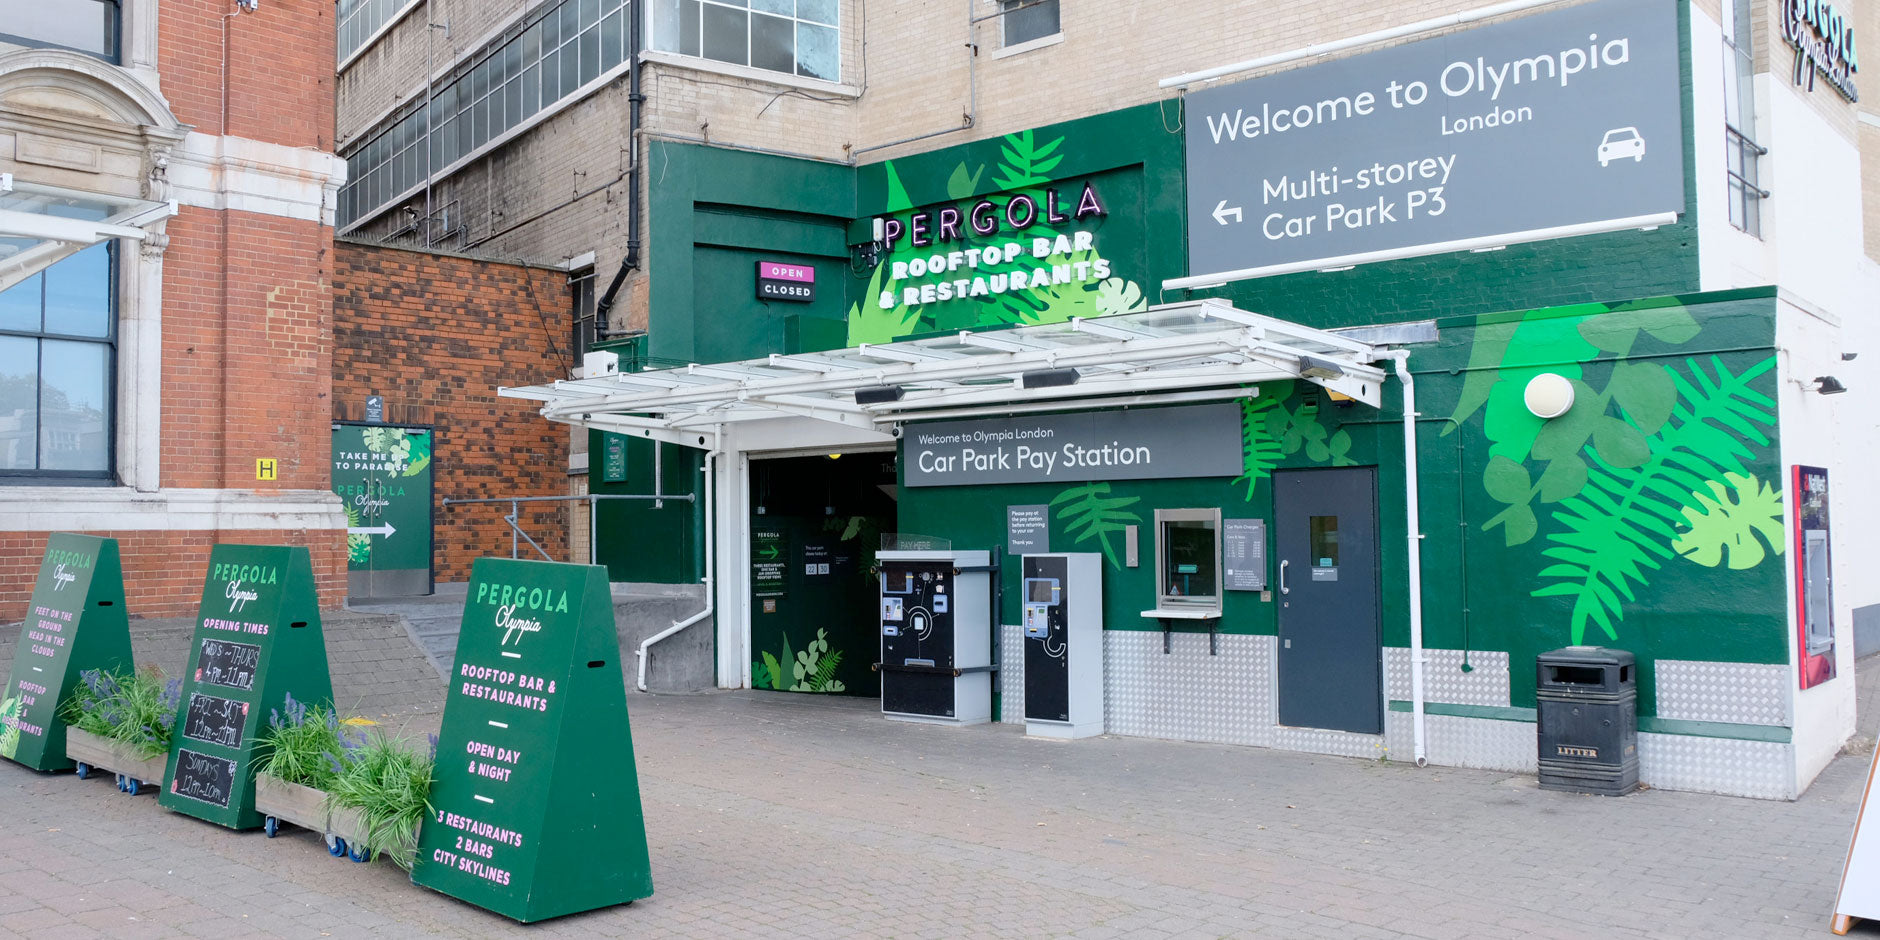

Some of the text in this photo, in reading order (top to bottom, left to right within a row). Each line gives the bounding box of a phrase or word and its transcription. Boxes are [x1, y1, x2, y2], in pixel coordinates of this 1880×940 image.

[1206, 33, 1630, 144] Welcome to Olympia
[1441, 105, 1532, 136] London
[1262, 154, 1456, 204] Multi-storey
[884, 183, 1105, 251] PERGOLA
[1262, 186, 1447, 240] Car Park P3
[892, 230, 1093, 280] ROOFTOP BAR
[772, 267, 803, 278] OPEN
[879, 258, 1111, 309] & RESTAURANTS
[764, 284, 811, 296] CLOSED
[918, 427, 1054, 445] Welcome to Olympia London
[340, 452, 368, 460] TAKE
[354, 462, 408, 471] PARADSE
[918, 441, 1150, 476] Car Park Pay Station
[260, 460, 273, 478] H
[337, 484, 406, 496] PERGOLA
[900, 541, 931, 549] PAY HERE
[46, 549, 91, 569] PERGOLA
[53, 563, 76, 591] Olympia
[213, 563, 277, 585] PERGOLA
[225, 579, 258, 613] Olympia
[476, 582, 568, 613] PERGOLA
[34, 606, 73, 621] FEET ON THE
[495, 603, 541, 646] Olympia
[38, 619, 62, 632] GROUND
[203, 618, 269, 635] OPENING TIMES
[28, 630, 65, 646] HEAD IN THE
[31, 644, 55, 657] CLOUDS
[18, 680, 47, 695] ROOFTOP
[461, 663, 556, 694] ROOFTOP BAR &
[22, 694, 35, 706] BAR
[462, 682, 547, 712] RESTAURANTS
[2, 714, 43, 736] RESAURANTS
[466, 740, 521, 764] OPEN DAY
[1557, 746, 1597, 758] LITTER
[468, 760, 512, 782] & NIGHT
[437, 810, 522, 847] 3 RESTAURANTS
[455, 836, 494, 859] 2 BARS
[433, 848, 511, 886] CITY SKYLINES
